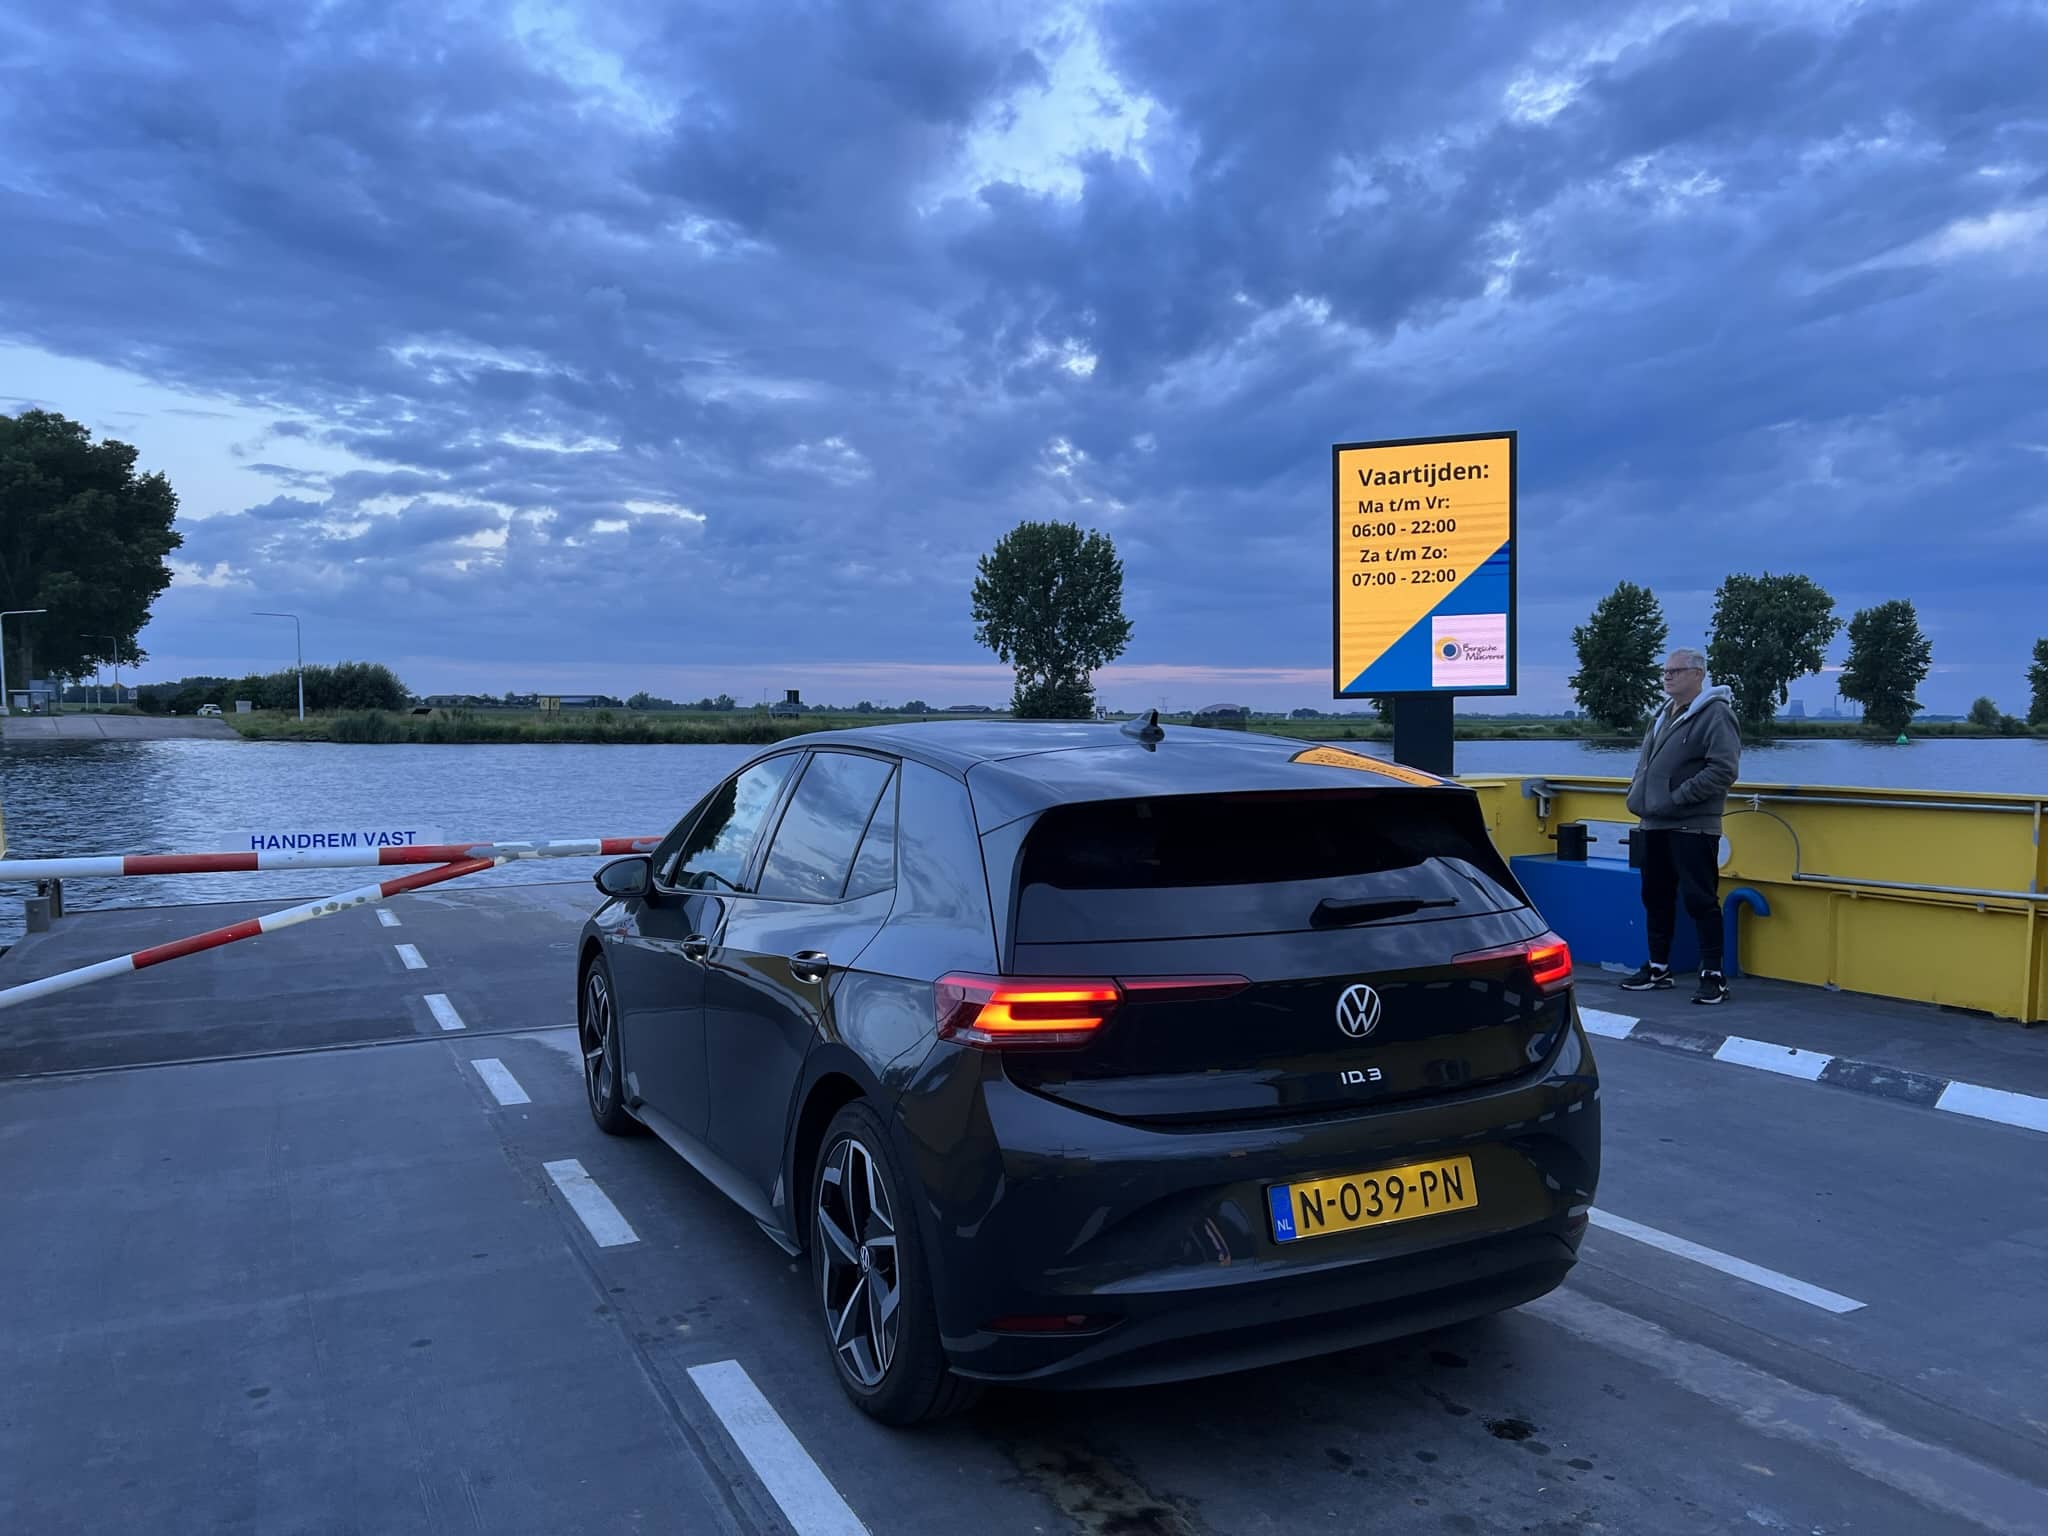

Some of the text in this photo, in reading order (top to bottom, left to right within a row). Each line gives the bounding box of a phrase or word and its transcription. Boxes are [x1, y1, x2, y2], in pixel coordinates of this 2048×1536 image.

[1358, 462, 1489, 488] Vaartijden:
[1358, 496, 1450, 514] Ma t/m Vr:
[1352, 522, 1396, 538] 06:00
[1411, 519, 1456, 535] 22:00
[1360, 546, 1448, 563] Za t/m Zo:
[1352, 572, 1396, 587] 07:00
[1411, 569, 1456, 584] 22:00
[251, 831, 417, 850] HANDREM VAST
[1299, 1165, 1464, 1229] N-039-PN
[1277, 1219, 1292, 1232] NL
